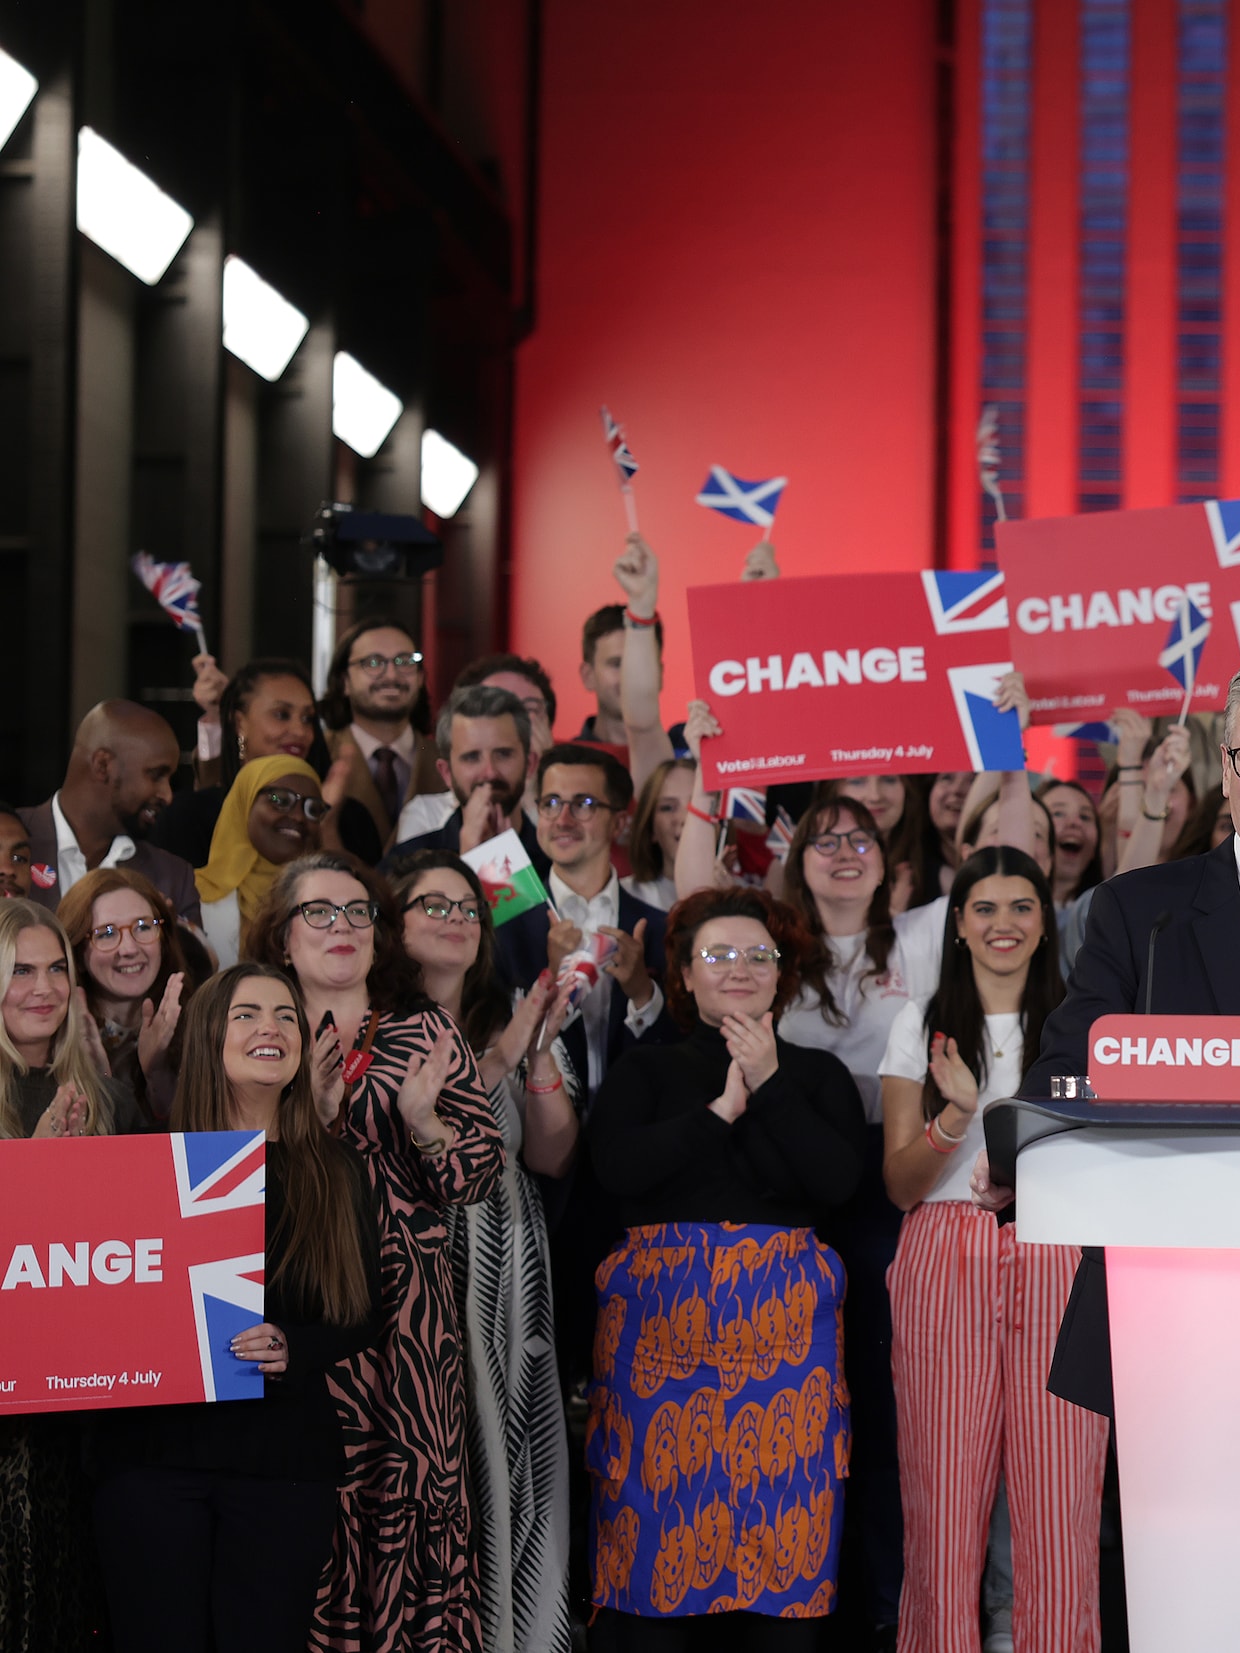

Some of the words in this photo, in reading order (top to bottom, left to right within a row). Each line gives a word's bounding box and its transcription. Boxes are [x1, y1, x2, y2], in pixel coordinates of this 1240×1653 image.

[1016, 582, 1213, 634] CHANGE
[709, 646, 927, 697] CHANGE
[717, 759, 751, 774] Vote
[760, 753, 806, 768] Labour
[830, 747, 893, 762] Thursday
[895, 745, 904, 757] 4
[905, 745, 934, 760] July
[1, 1238, 163, 1290] ANGE
[46, 1373, 116, 1390] Thursday
[118, 1371, 128, 1385] 4
[131, 1370, 162, 1387] July
